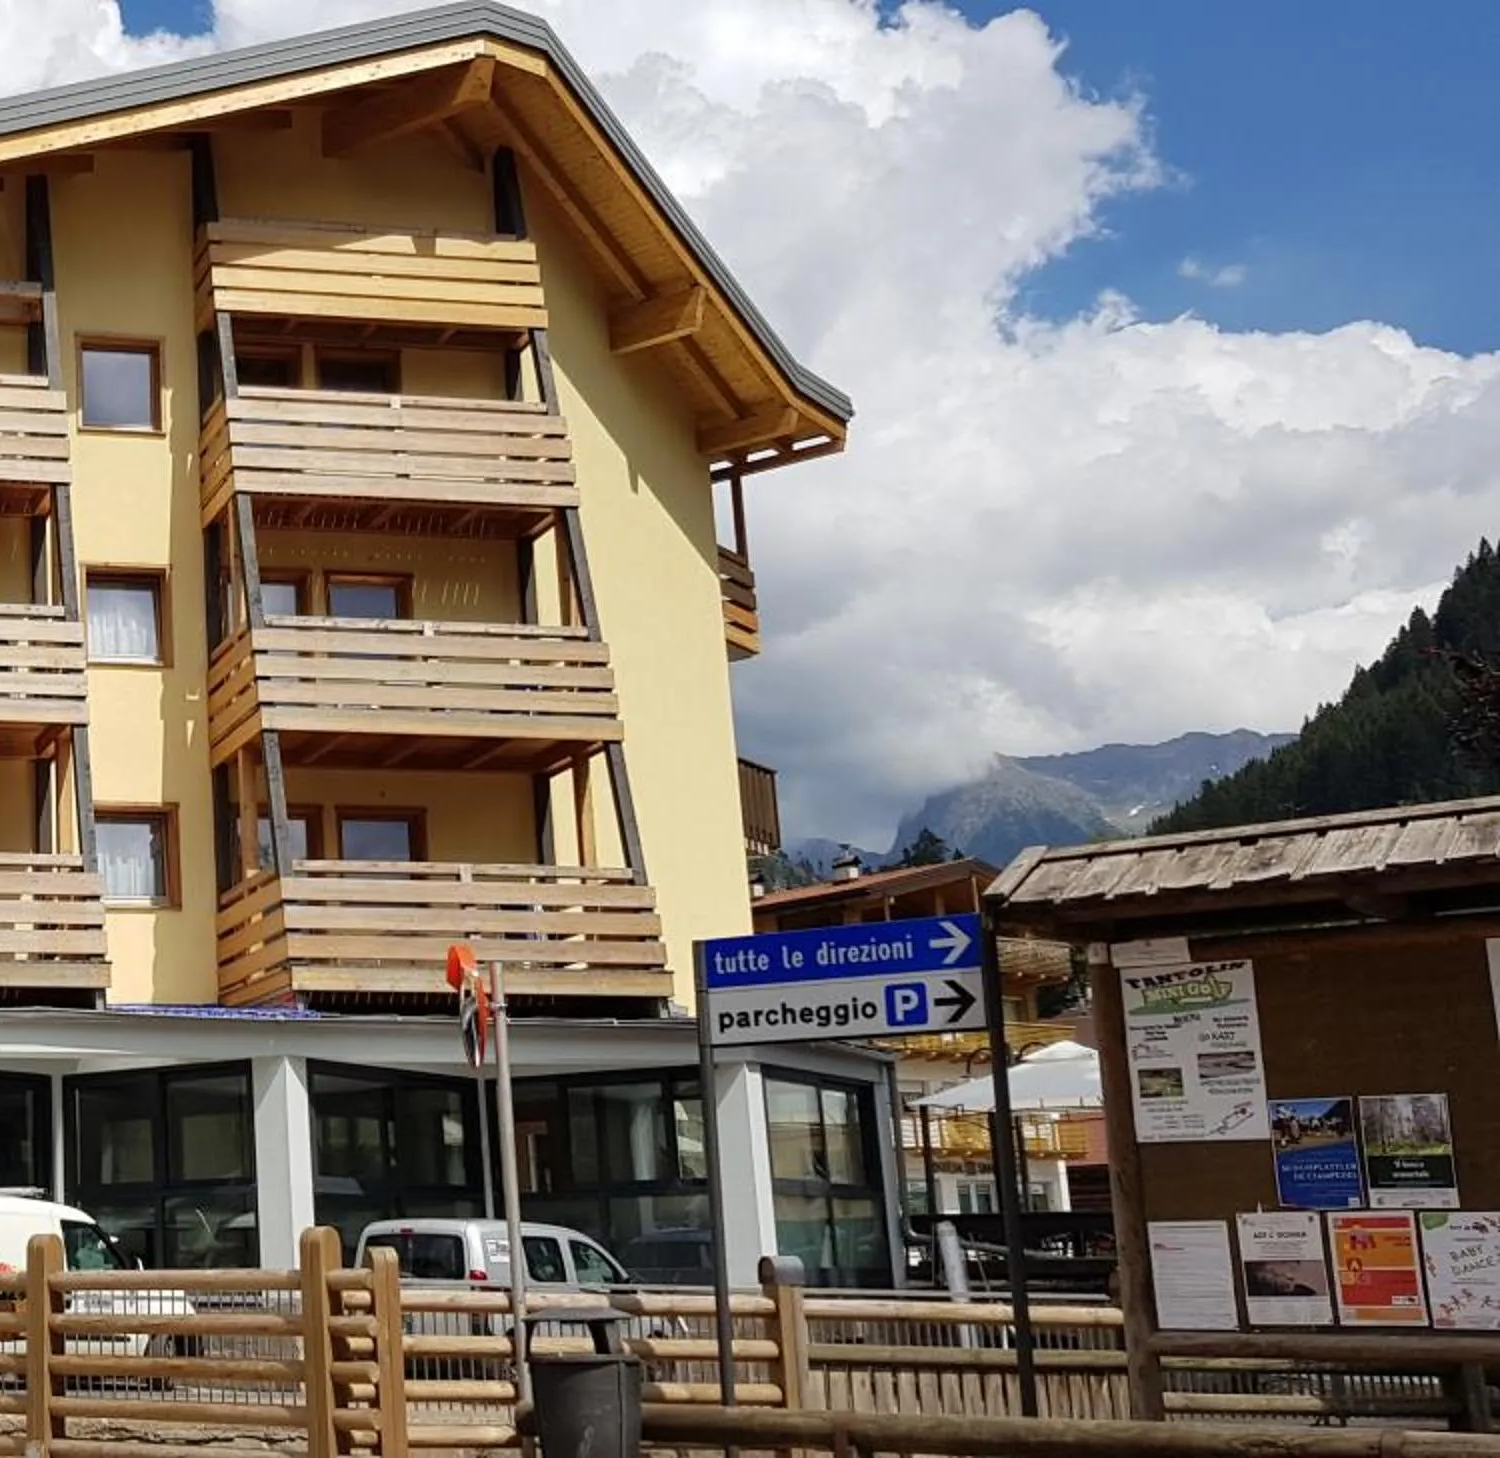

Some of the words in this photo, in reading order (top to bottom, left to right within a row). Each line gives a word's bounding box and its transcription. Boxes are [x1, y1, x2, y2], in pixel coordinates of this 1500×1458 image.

[714, 951, 769, 975] tutte
[782, 945, 804, 969] le
[816, 934, 914, 966] direzioni
[1124, 961, 1247, 989] TANTOLIN
[718, 996, 878, 1033] parcheggio
[893, 988, 920, 1022] P
